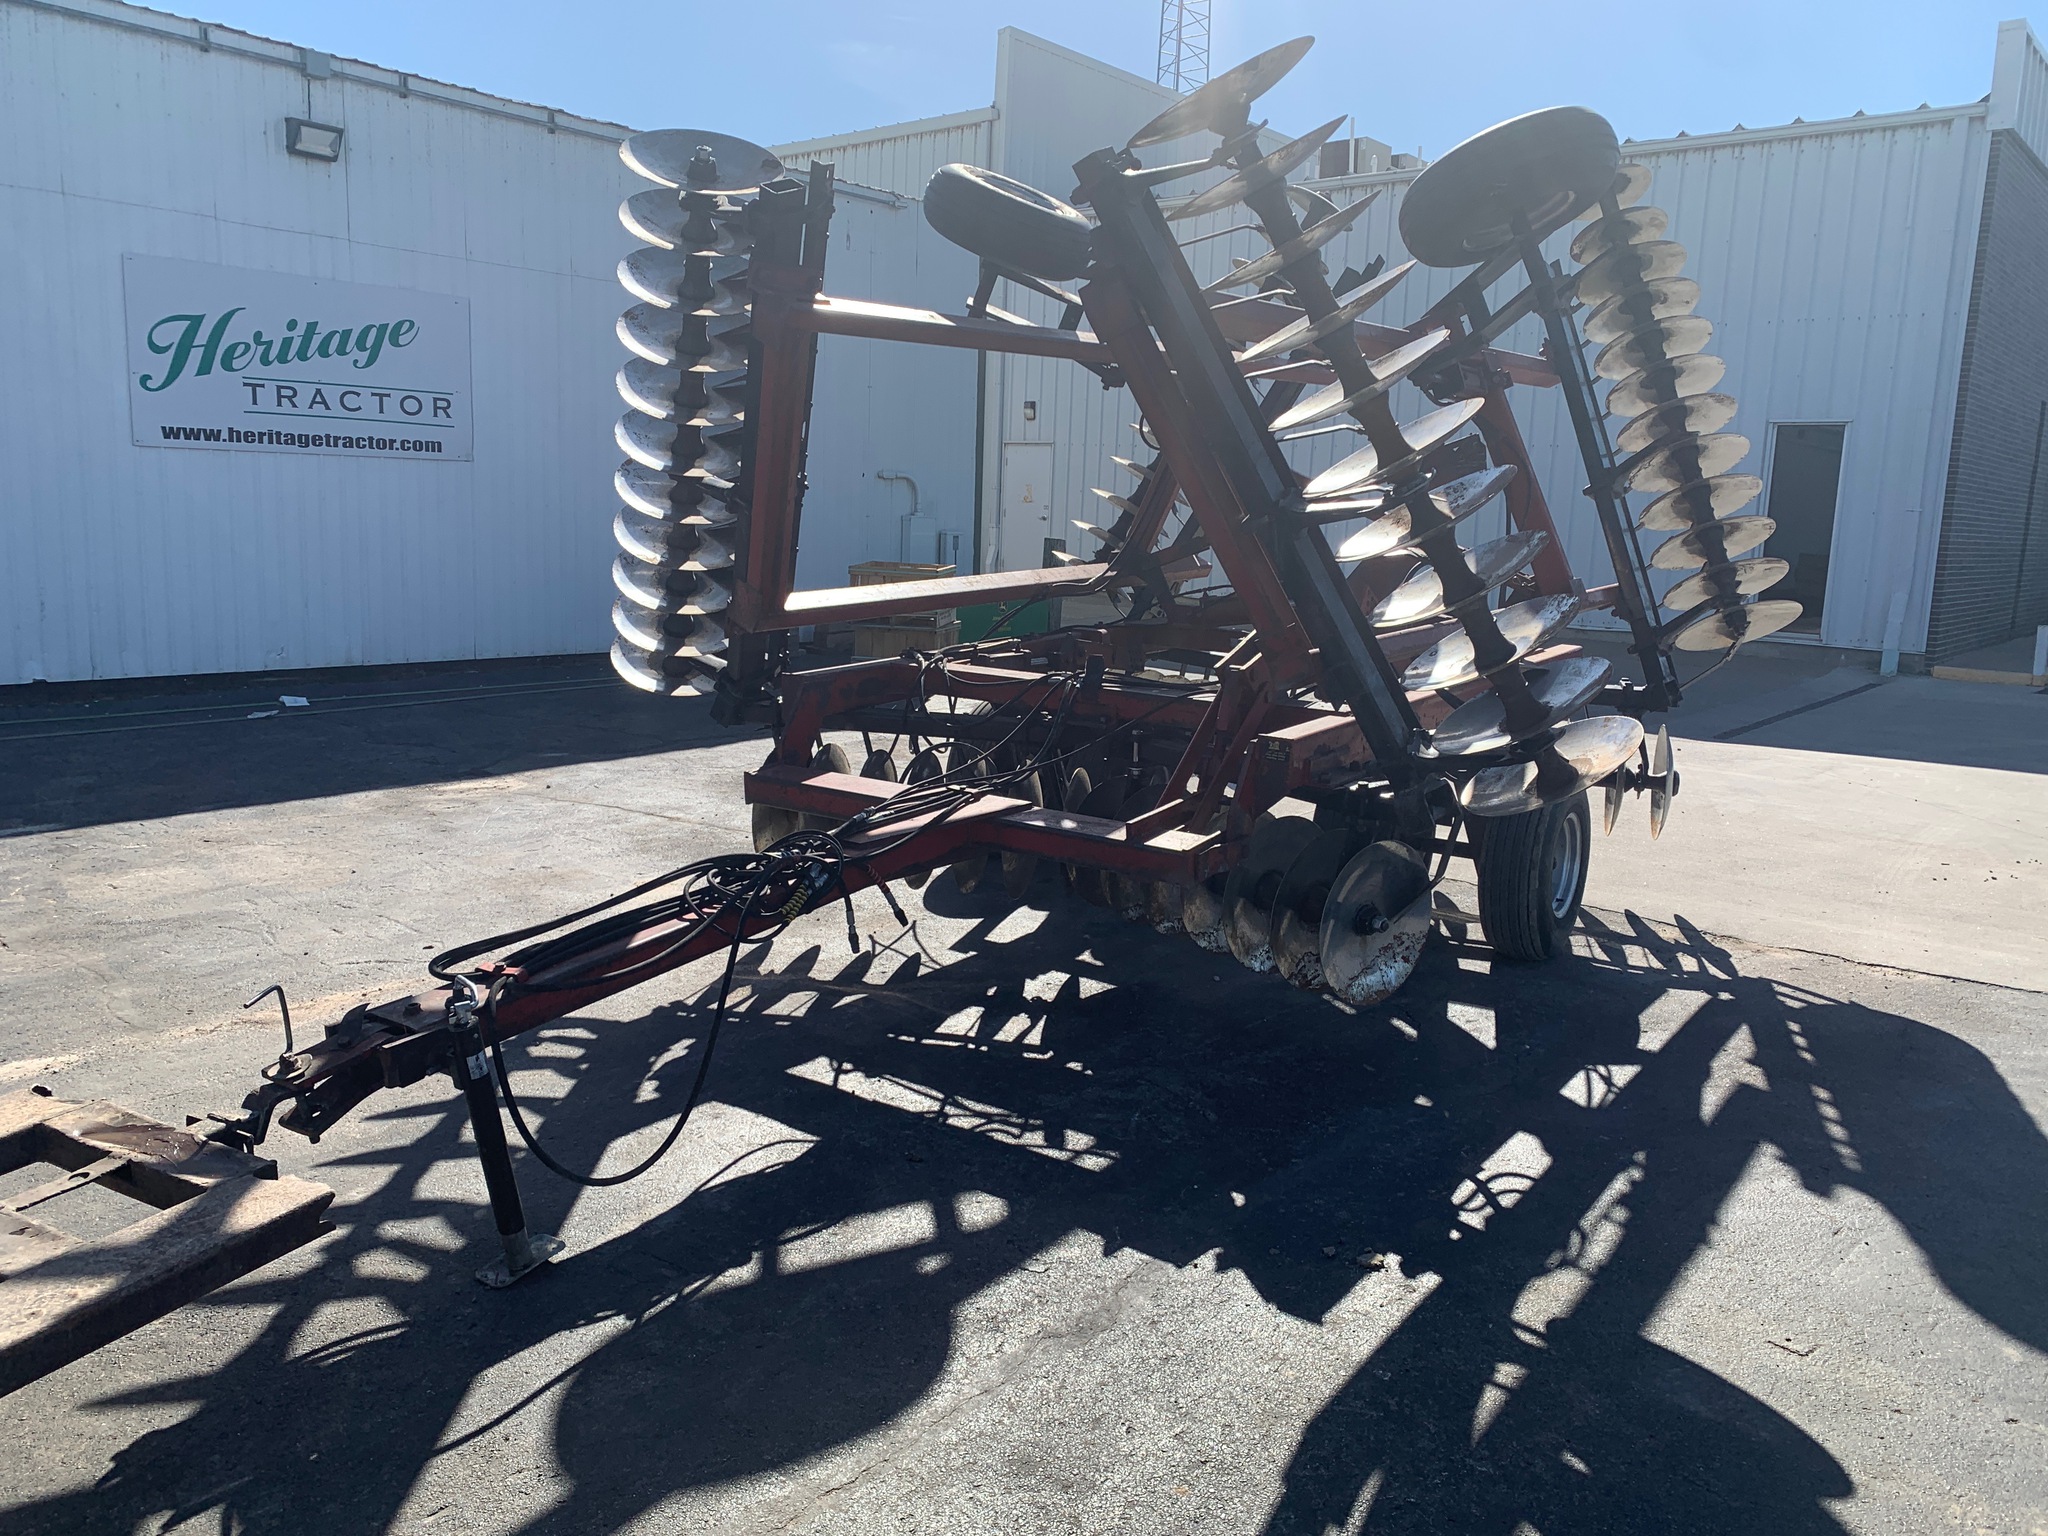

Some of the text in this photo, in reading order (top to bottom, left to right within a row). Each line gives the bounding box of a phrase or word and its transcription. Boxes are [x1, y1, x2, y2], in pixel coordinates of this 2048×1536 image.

[139, 307, 420, 392] Heritage
[242, 381, 452, 419] TRACTOR
[161, 425, 443, 453] www.heritagetractor.com
